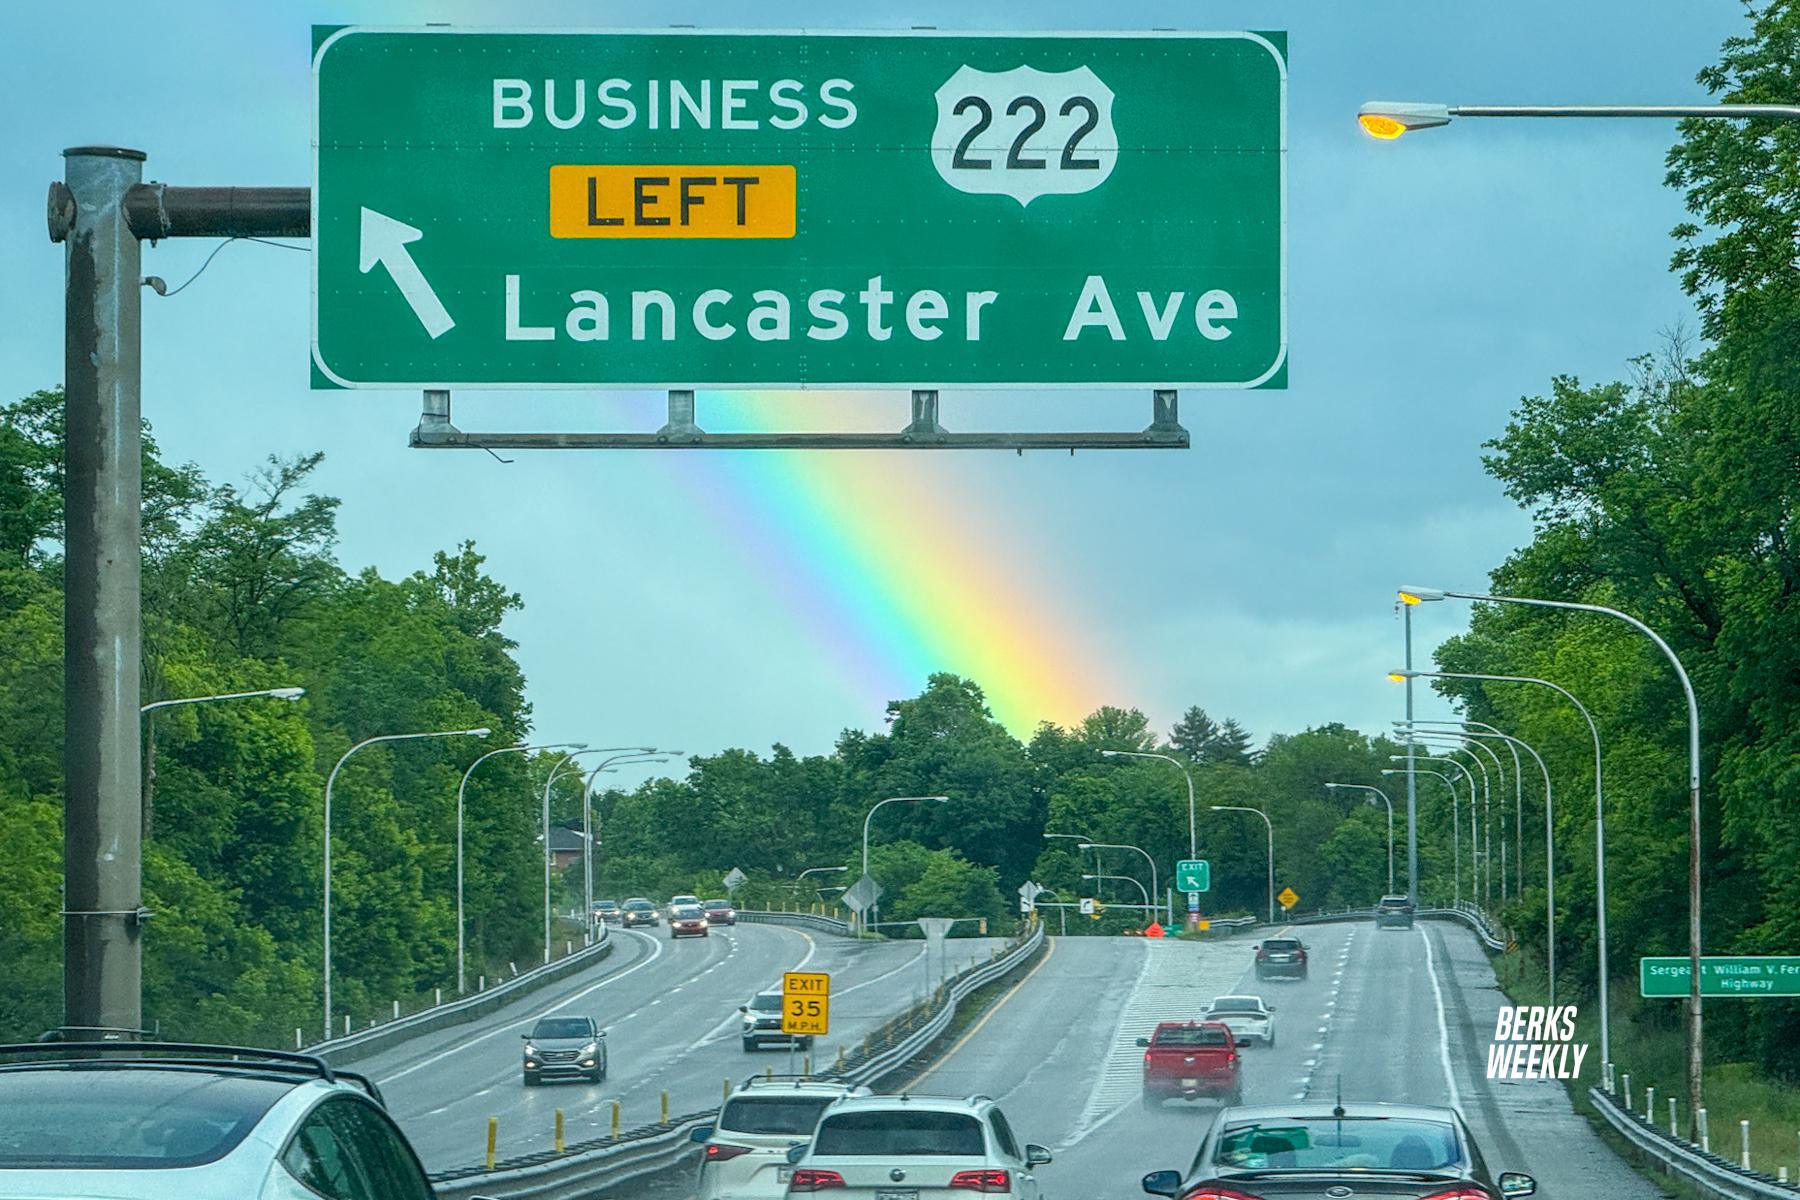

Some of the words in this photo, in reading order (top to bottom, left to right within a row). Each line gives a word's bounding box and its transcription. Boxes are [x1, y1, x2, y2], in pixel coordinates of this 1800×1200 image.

[493, 79, 857, 129] BUSINESS
[952, 95, 1101, 171] 222
[587, 176, 760, 227] LEFT
[505, 274, 998, 342] Lancaster
[1063, 275, 1238, 341] Ave
[1181, 863, 1204, 871] EXIT
[1650, 965, 1707, 977] Sergeat
[1713, 963, 1761, 975] William
[1766, 965, 1778, 975] V.
[789, 978, 824, 991] EXIT
[1720, 978, 1774, 991] Highway
[791, 1000, 820, 1017] 35
